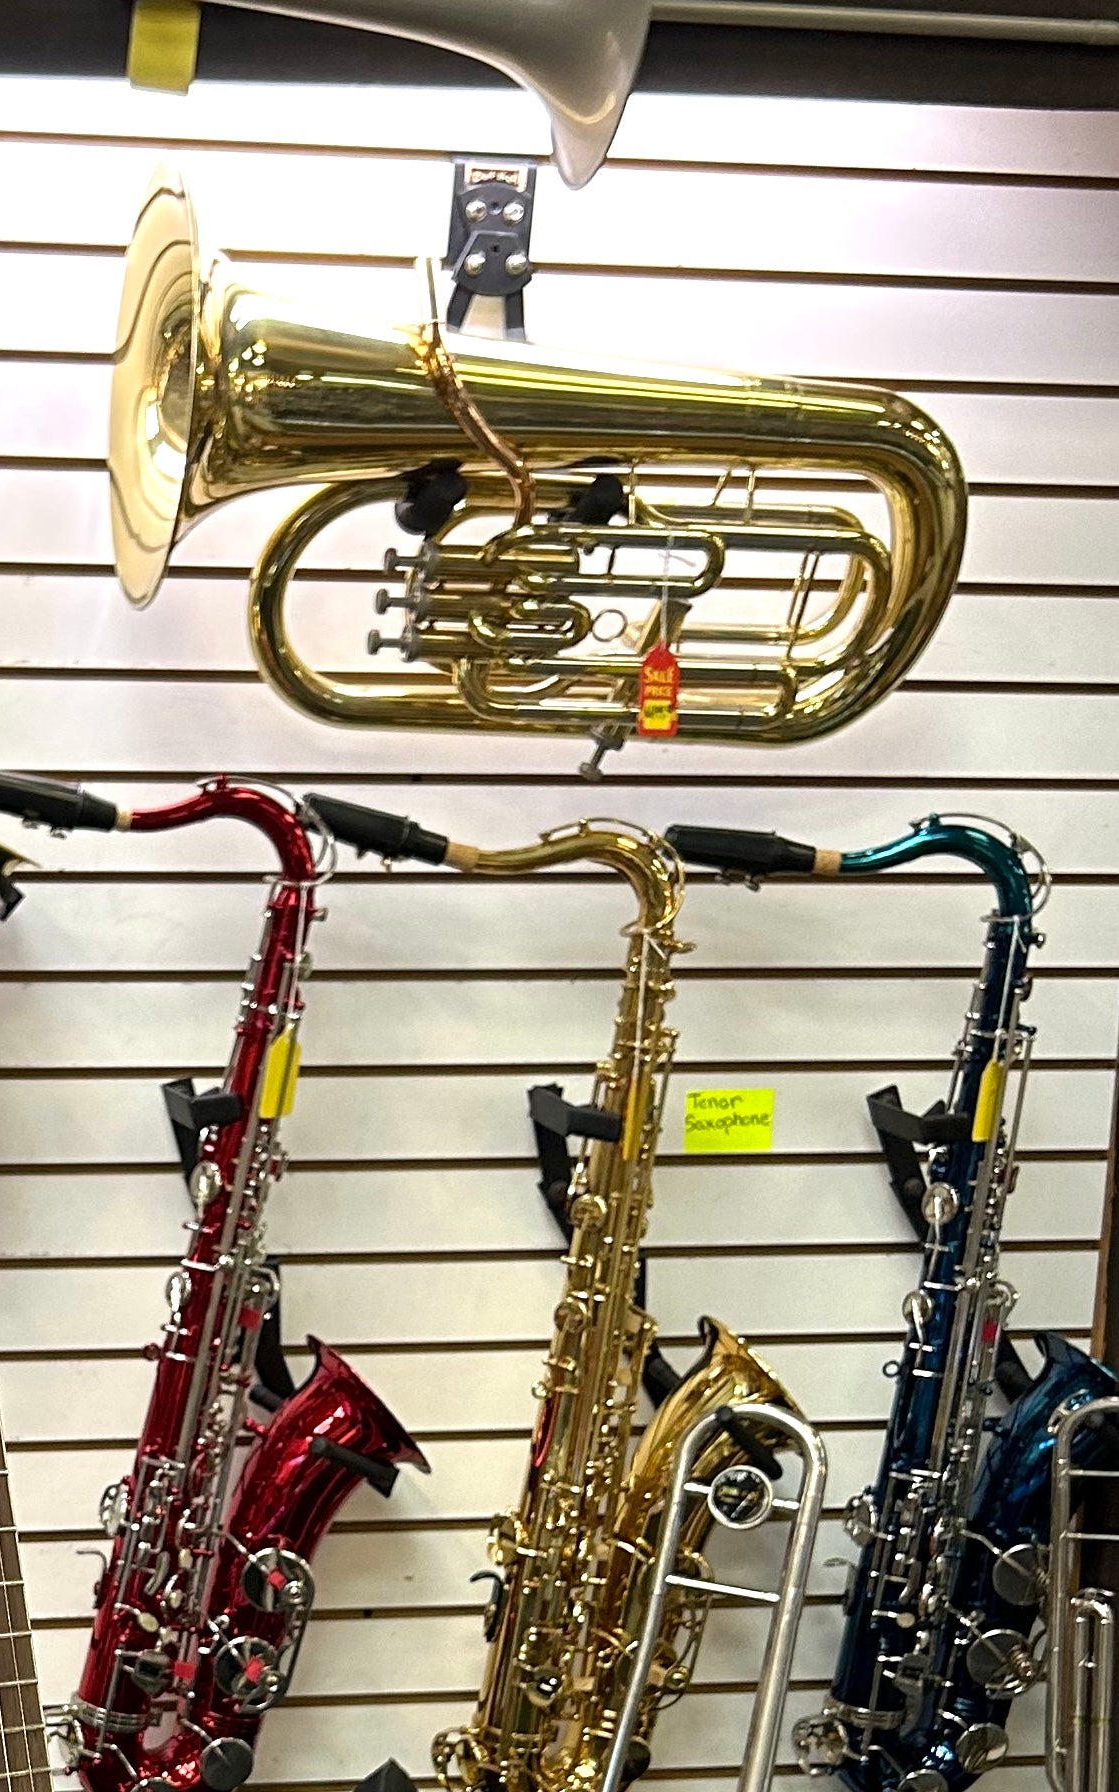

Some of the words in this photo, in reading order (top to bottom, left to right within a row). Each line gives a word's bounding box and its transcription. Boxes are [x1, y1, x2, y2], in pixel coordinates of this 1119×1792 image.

[643, 666, 675, 683] SALE
[687, 1092, 743, 1110] Tenor
[685, 1112, 770, 1135] Saxophone
